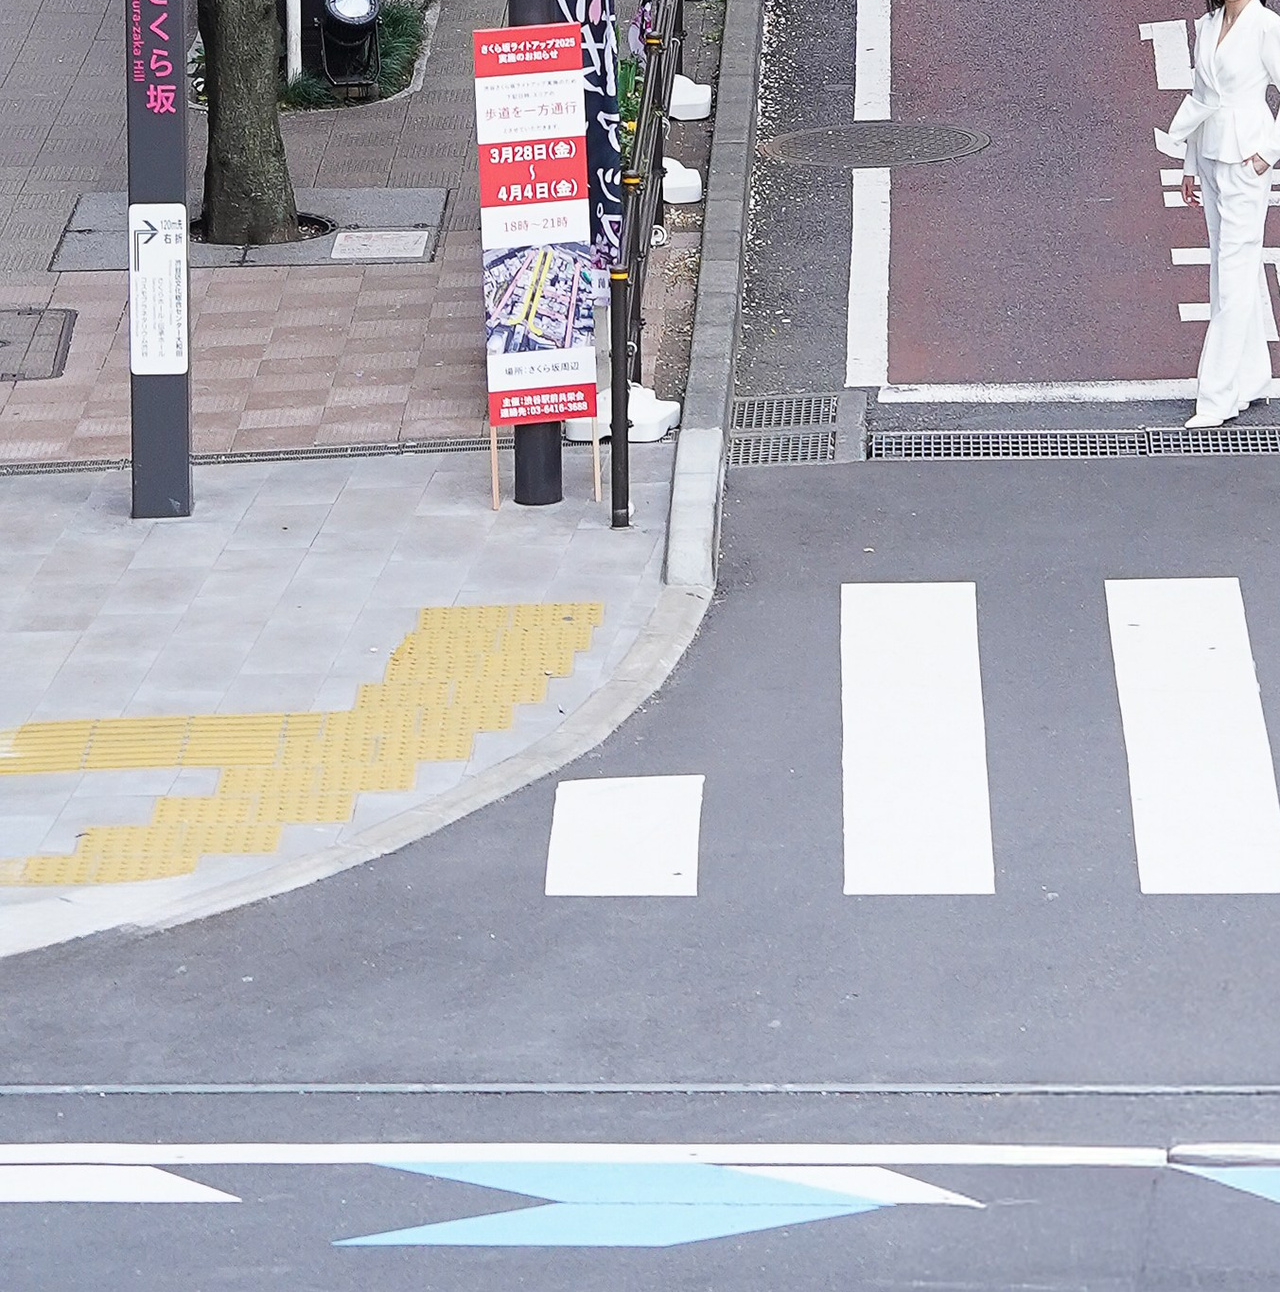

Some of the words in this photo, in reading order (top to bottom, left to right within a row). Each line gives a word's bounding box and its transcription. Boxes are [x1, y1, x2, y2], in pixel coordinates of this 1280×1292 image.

[480, 37, 576, 55] さくら坂ライトアップ2025
[133, 60, 146, 82] Hill
[485, 101, 577, 121] 歩道を一方通行
[489, 139, 577, 164] 3月28日(金)
[497, 178, 578, 202] 4月4日(金)
